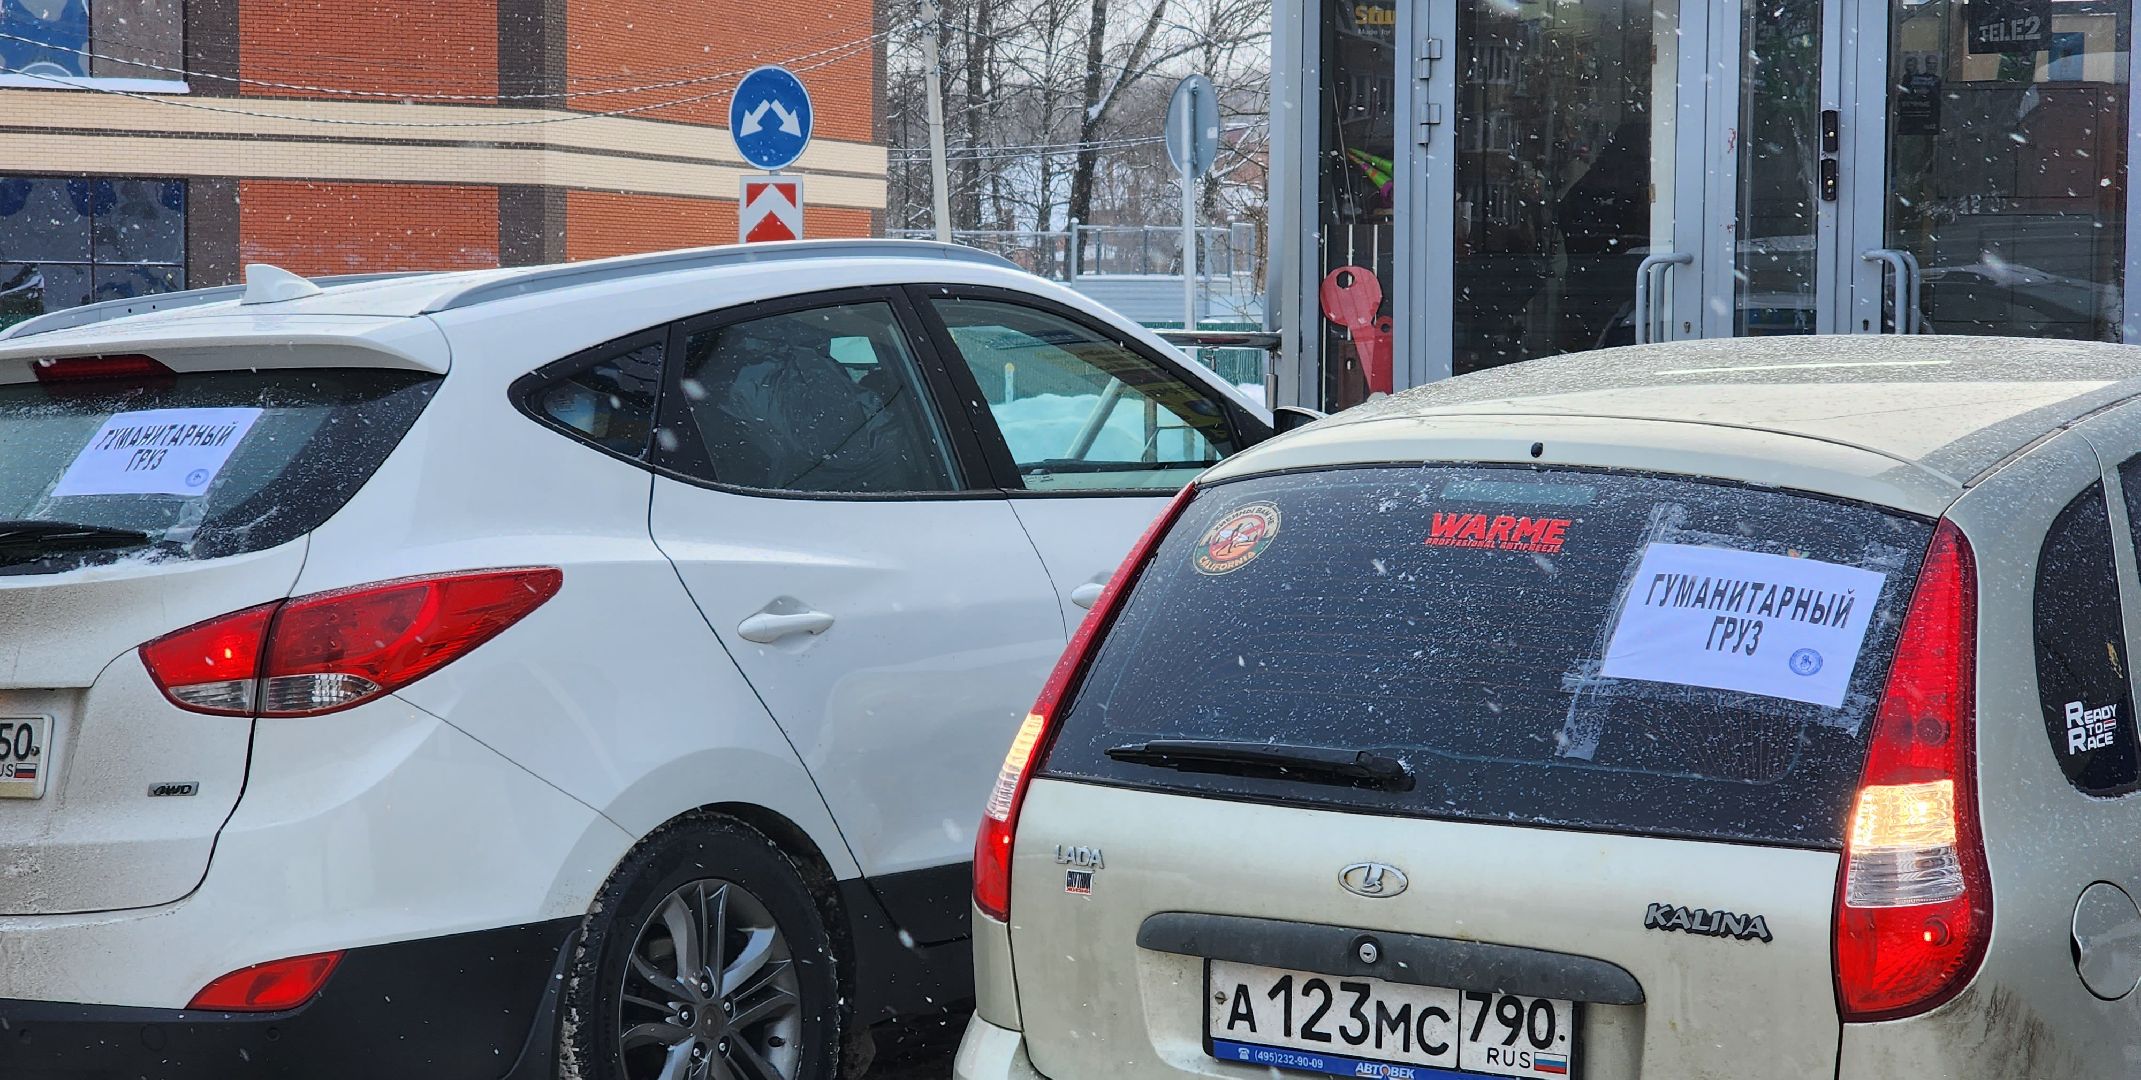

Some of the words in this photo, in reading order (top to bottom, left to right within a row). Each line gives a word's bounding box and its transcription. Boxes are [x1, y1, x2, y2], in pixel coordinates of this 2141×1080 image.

[1979, 15, 2041, 42] TELE2
[95, 421, 239, 450] ГУМАНИТАРНЫЙ
[125, 448, 168, 472] ГРУЗ
[1430, 512, 1572, 545] WARME
[1500, 541, 1561, 553] ANTIFREEZE
[1200, 551, 1256, 571] CALIFORNIA
[1645, 573, 1855, 629] ГУМАНИТАРНЫЙ
[1705, 615, 1764, 656] ГРУЗ
[2086, 722, 2103, 735] TO
[1055, 844, 1105, 869] LADA
[1644, 902, 1773, 943] KALINA
[1254, 1049, 1324, 1070] (495)232-90-09
[1486, 1047, 1531, 1069] RUS
[1355, 1061, 1415, 1080] АВТОВЕК
